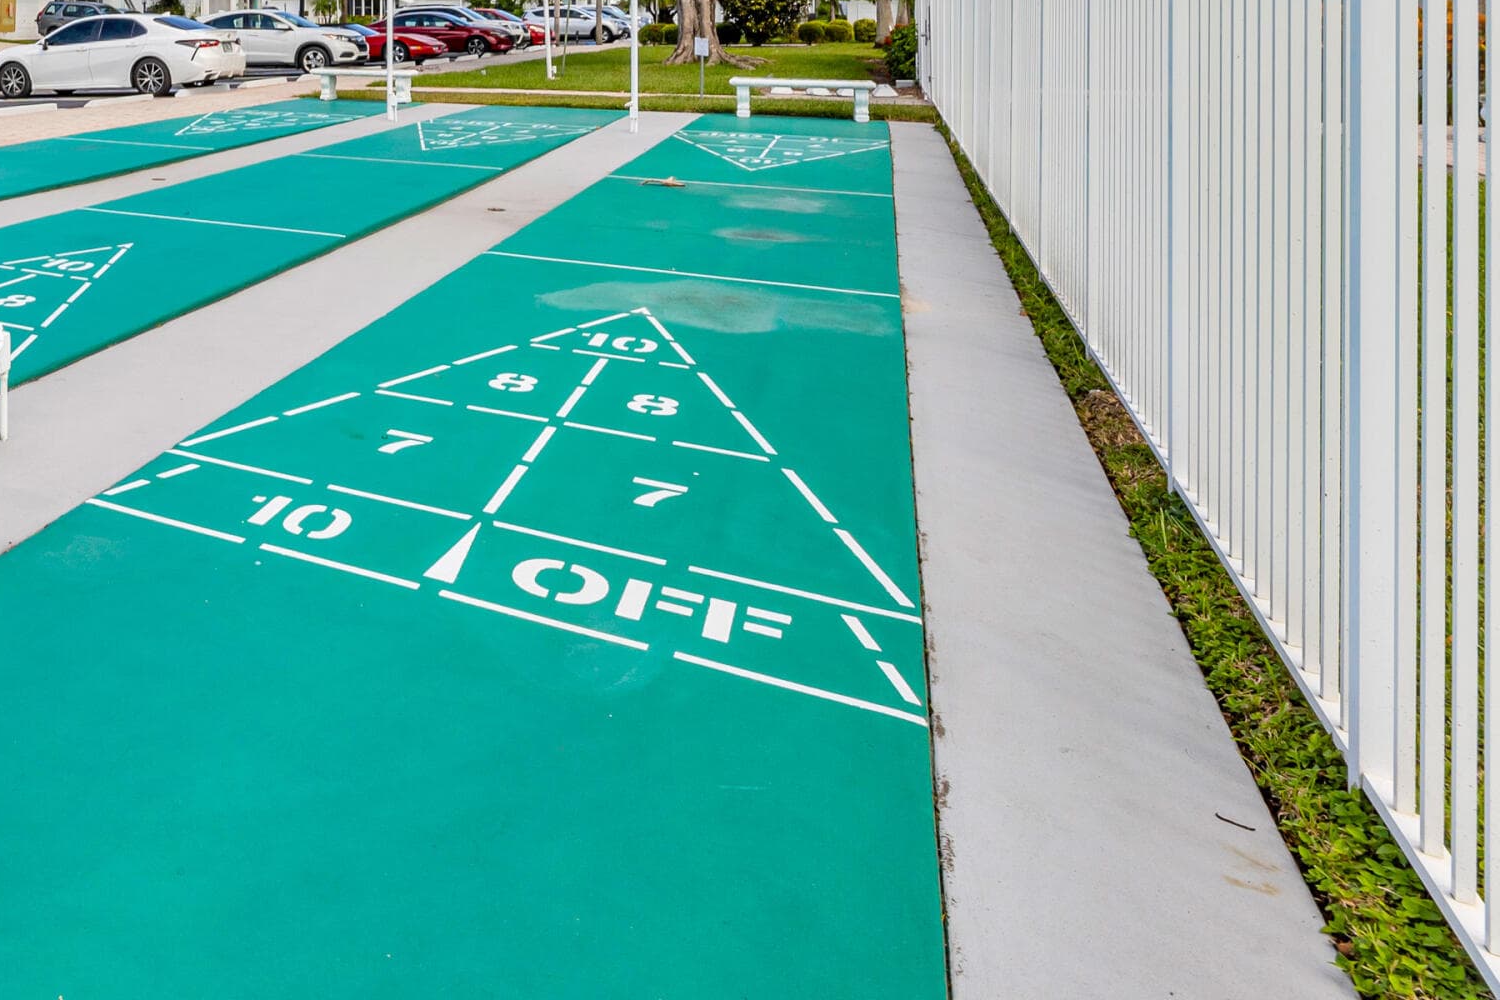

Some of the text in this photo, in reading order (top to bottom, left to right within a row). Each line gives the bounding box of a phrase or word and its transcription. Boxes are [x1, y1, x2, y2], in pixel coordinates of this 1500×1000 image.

[41, 258, 95, 271] 10
[582, 331, 659, 353] 10
[488, 372, 679, 416] 8 8
[378, 429, 689, 507] 7 7
[247, 495, 793, 644] 10 OFF
